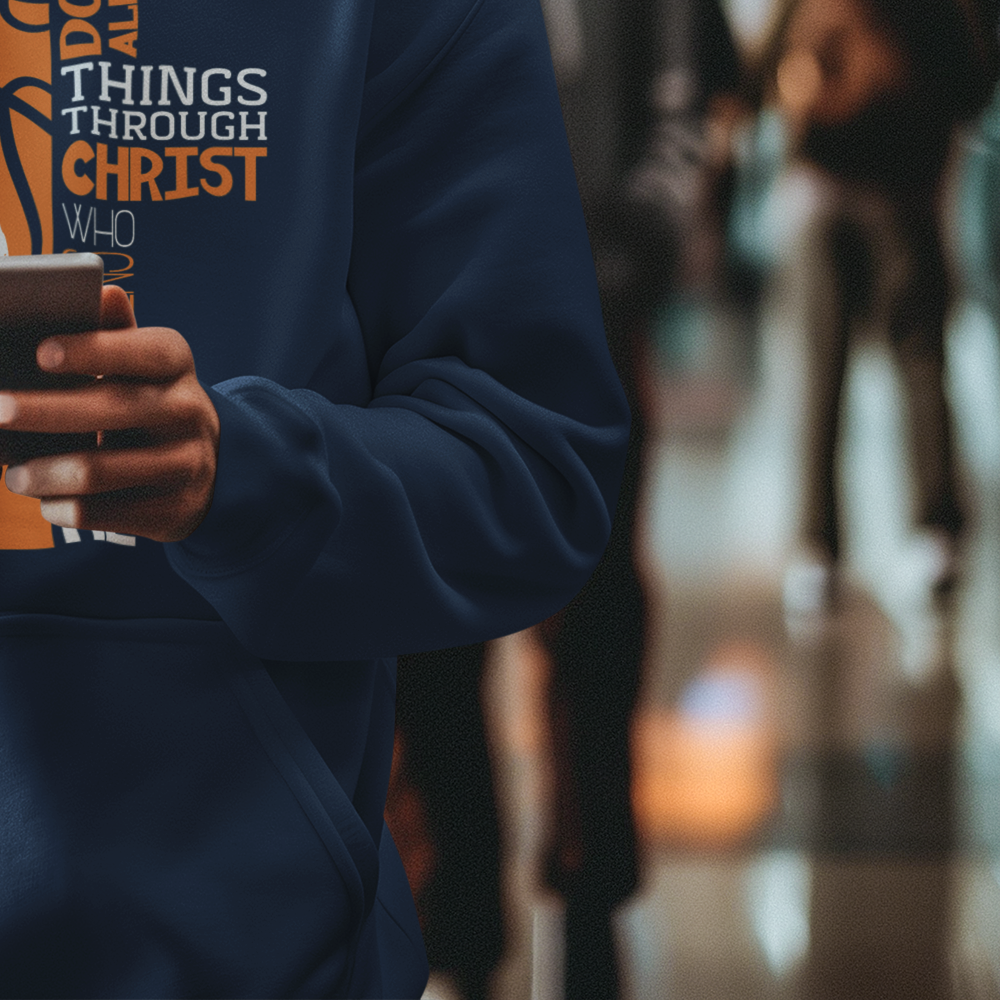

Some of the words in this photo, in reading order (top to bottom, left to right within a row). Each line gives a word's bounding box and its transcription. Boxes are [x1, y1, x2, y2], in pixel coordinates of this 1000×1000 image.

[60, 61, 268, 106] THINGS
[61, 105, 268, 141] THROUGH
[61, 139, 268, 202] CHRIST
[62, 202, 135, 248] WHO
